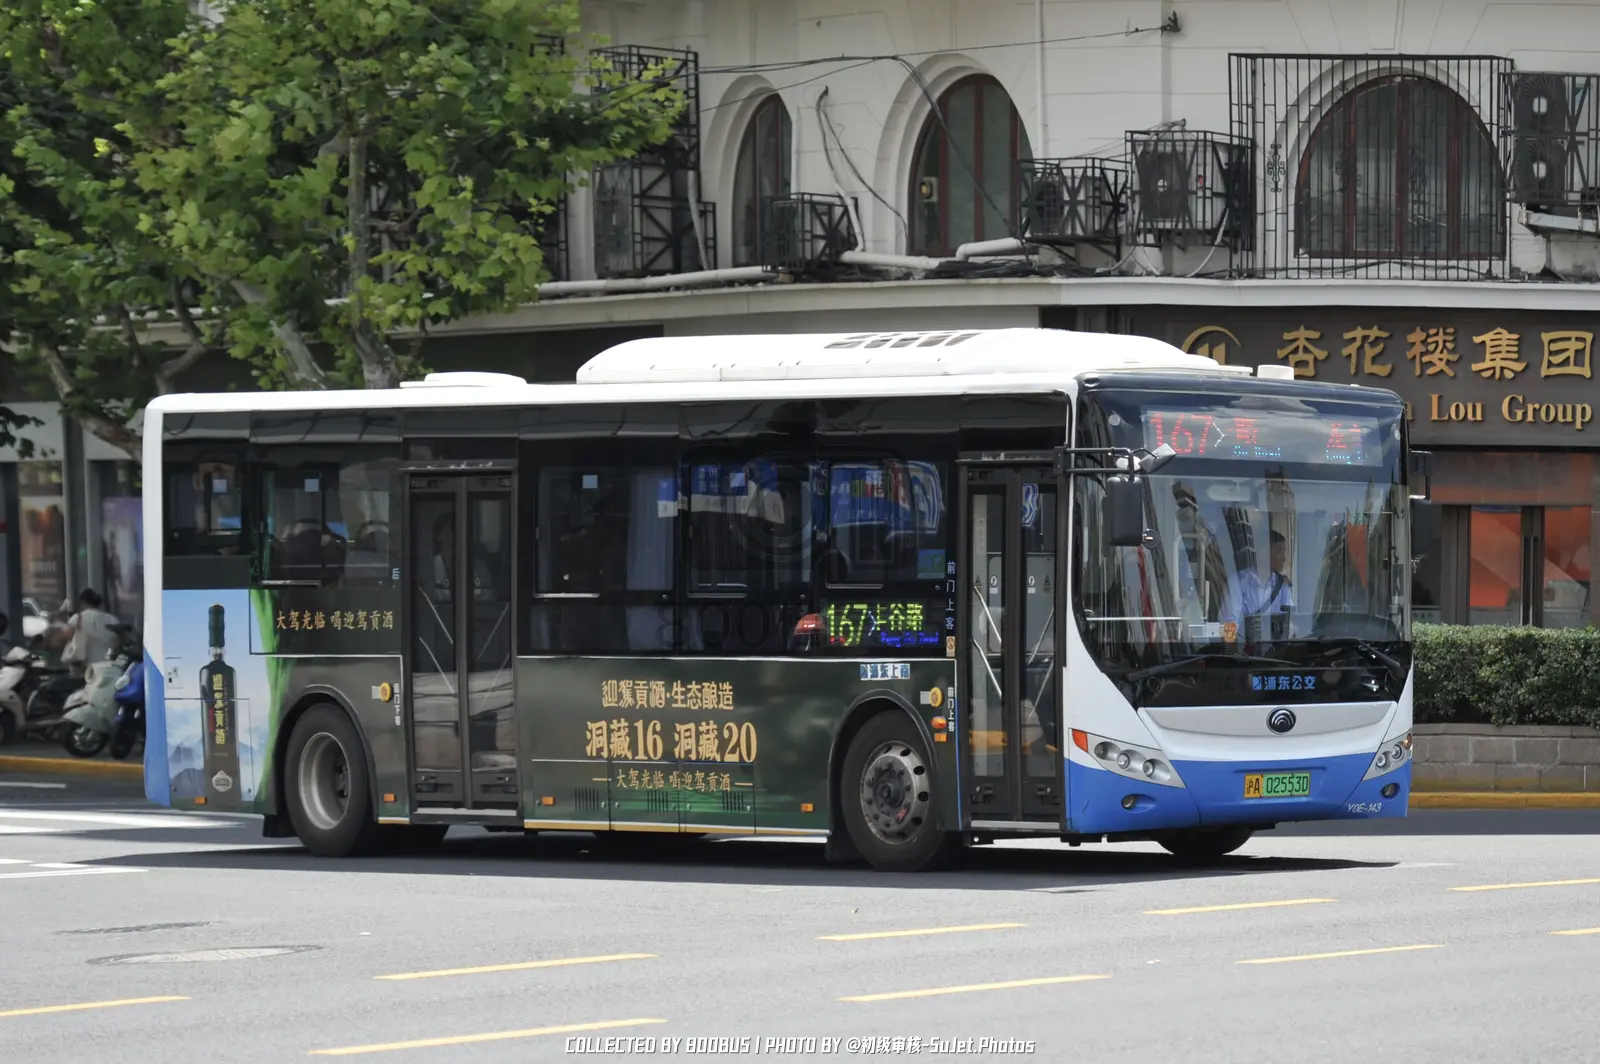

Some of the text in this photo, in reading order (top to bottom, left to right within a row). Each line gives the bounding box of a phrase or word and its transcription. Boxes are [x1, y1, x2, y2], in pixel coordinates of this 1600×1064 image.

[1276, 324, 1594, 380] 杏花楼集团
[1430, 393, 1484, 421] Lou
[1501, 394, 1592, 430] Group
[1150, 413, 1212, 455] 167
[945, 561, 956, 630] 前门上客
[276, 609, 394, 632] 大驾光临 喝迎驾贡酒
[827, 603, 868, 647] 167
[1263, 675, 1316, 690] 浦东公交
[585, 718, 758, 763] 洞藏16 洞藏20
[616, 768, 731, 792] 大驾光临 喝迎驾贡酒
